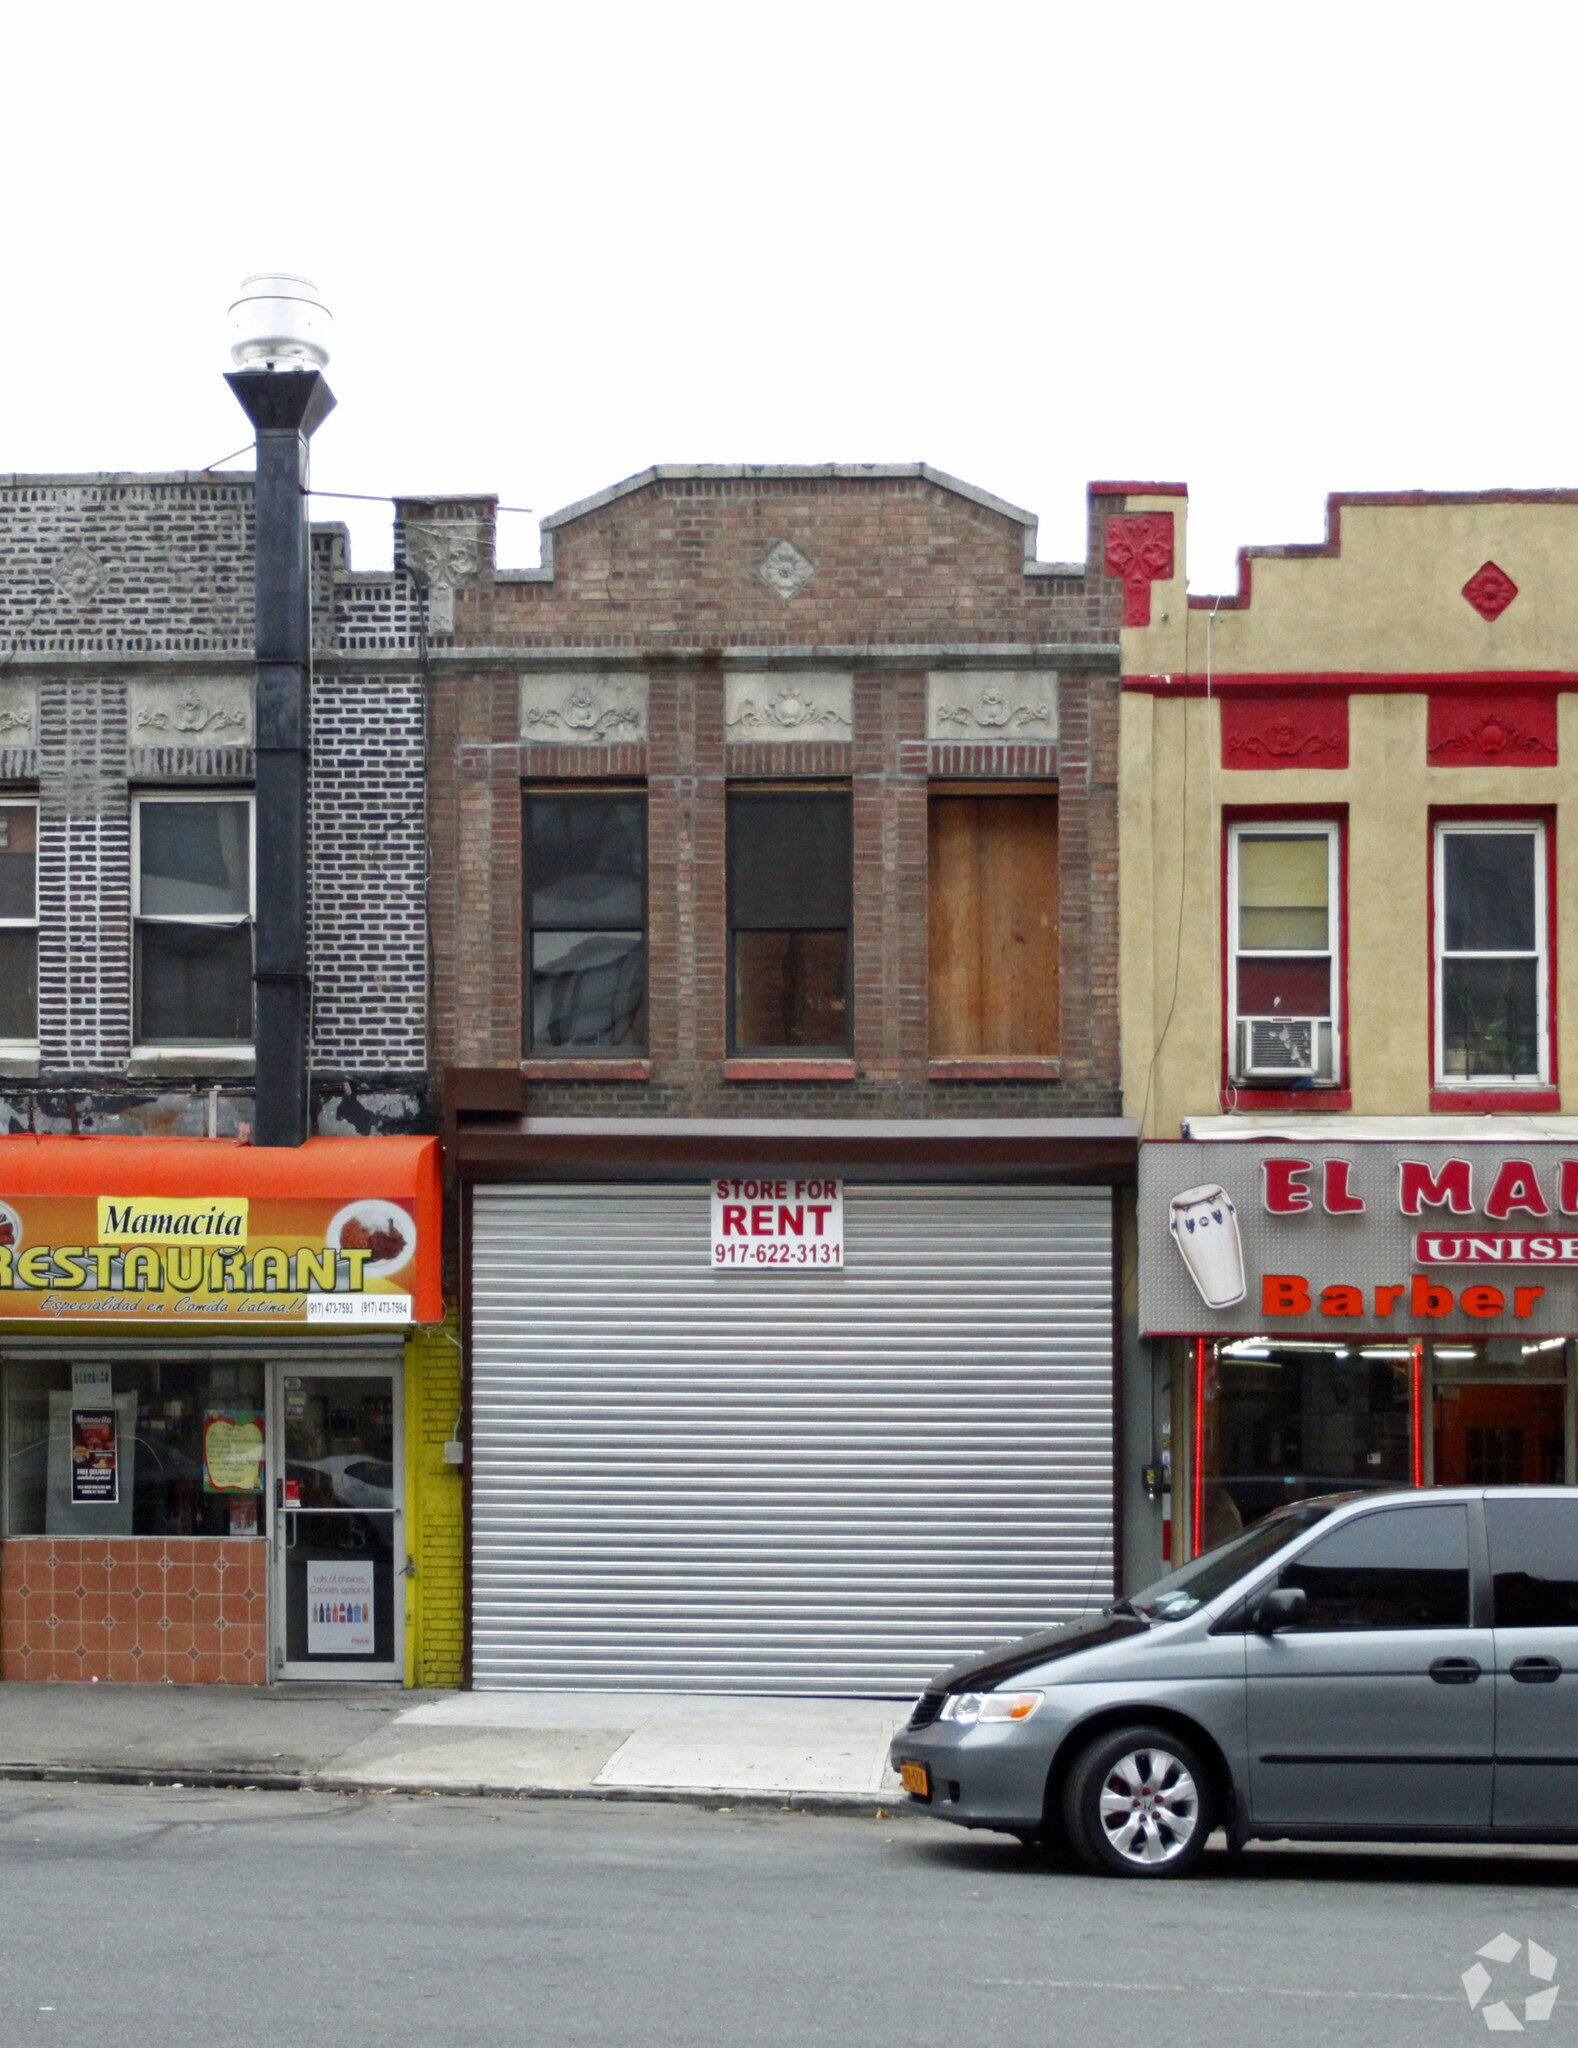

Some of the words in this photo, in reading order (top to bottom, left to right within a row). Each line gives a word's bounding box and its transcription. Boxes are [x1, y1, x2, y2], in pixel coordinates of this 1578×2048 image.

[716, 1180, 788, 1200] STORE
[794, 1180, 837, 1200] FOR
[1261, 1156, 1366, 1215] EL
[103, 1204, 243, 1237] Mamacita
[722, 1204, 832, 1236] RENT
[715, 1243, 840, 1264] 917-622-3131
[40, 1293, 139, 1317] Especialidad
[146, 1302, 165, 1313] en
[173, 1296, 230, 1313] Comida
[236, 1296, 307, 1314] Latina!!
[309, 1301, 324, 1317] (917)
[325, 1302, 354, 1314] 473-7593
[361, 1301, 377, 1316] (917)
[378, 1301, 408, 1314] 473-7594
[1261, 1273, 1546, 1318] Barber
